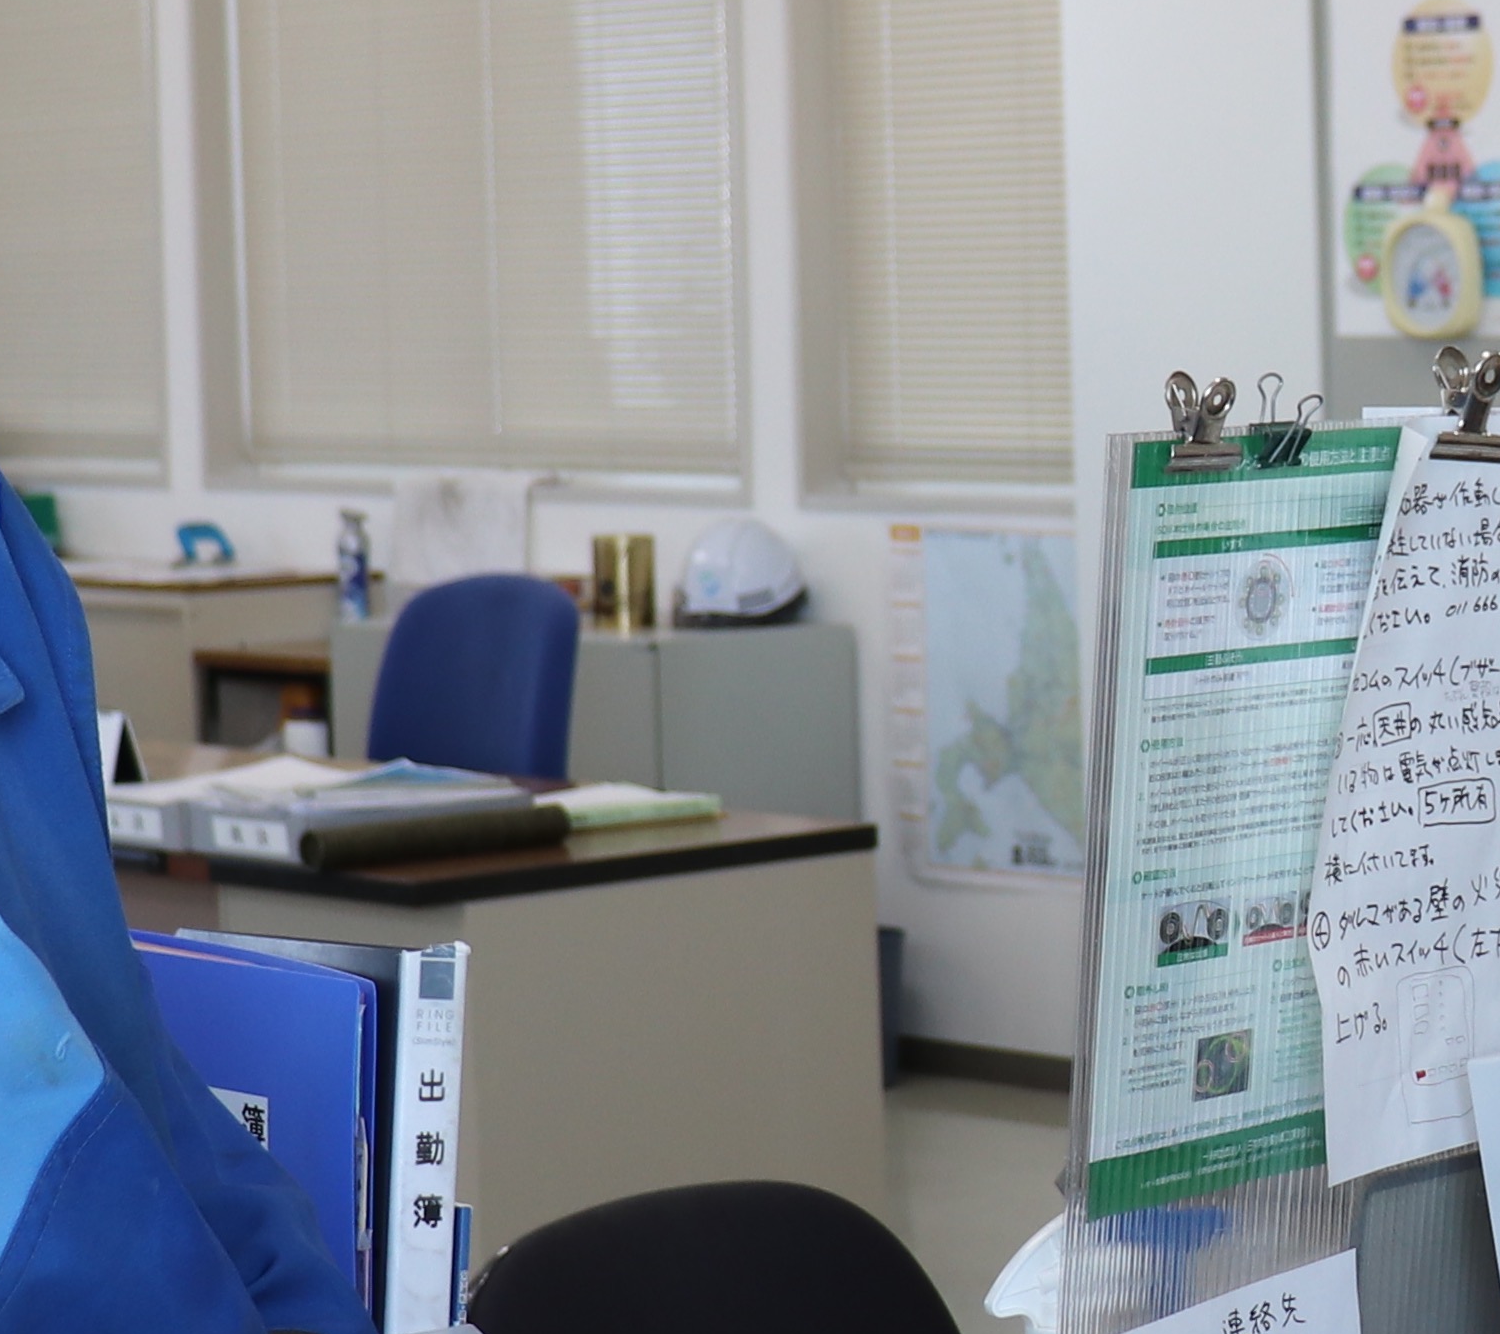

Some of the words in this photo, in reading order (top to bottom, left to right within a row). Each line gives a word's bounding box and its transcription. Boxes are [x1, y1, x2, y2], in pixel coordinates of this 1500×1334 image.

[416, 1009, 455, 1021] RING
[416, 1022, 454, 1033] FILE
[412, 1069, 446, 1229] 出勤簿
